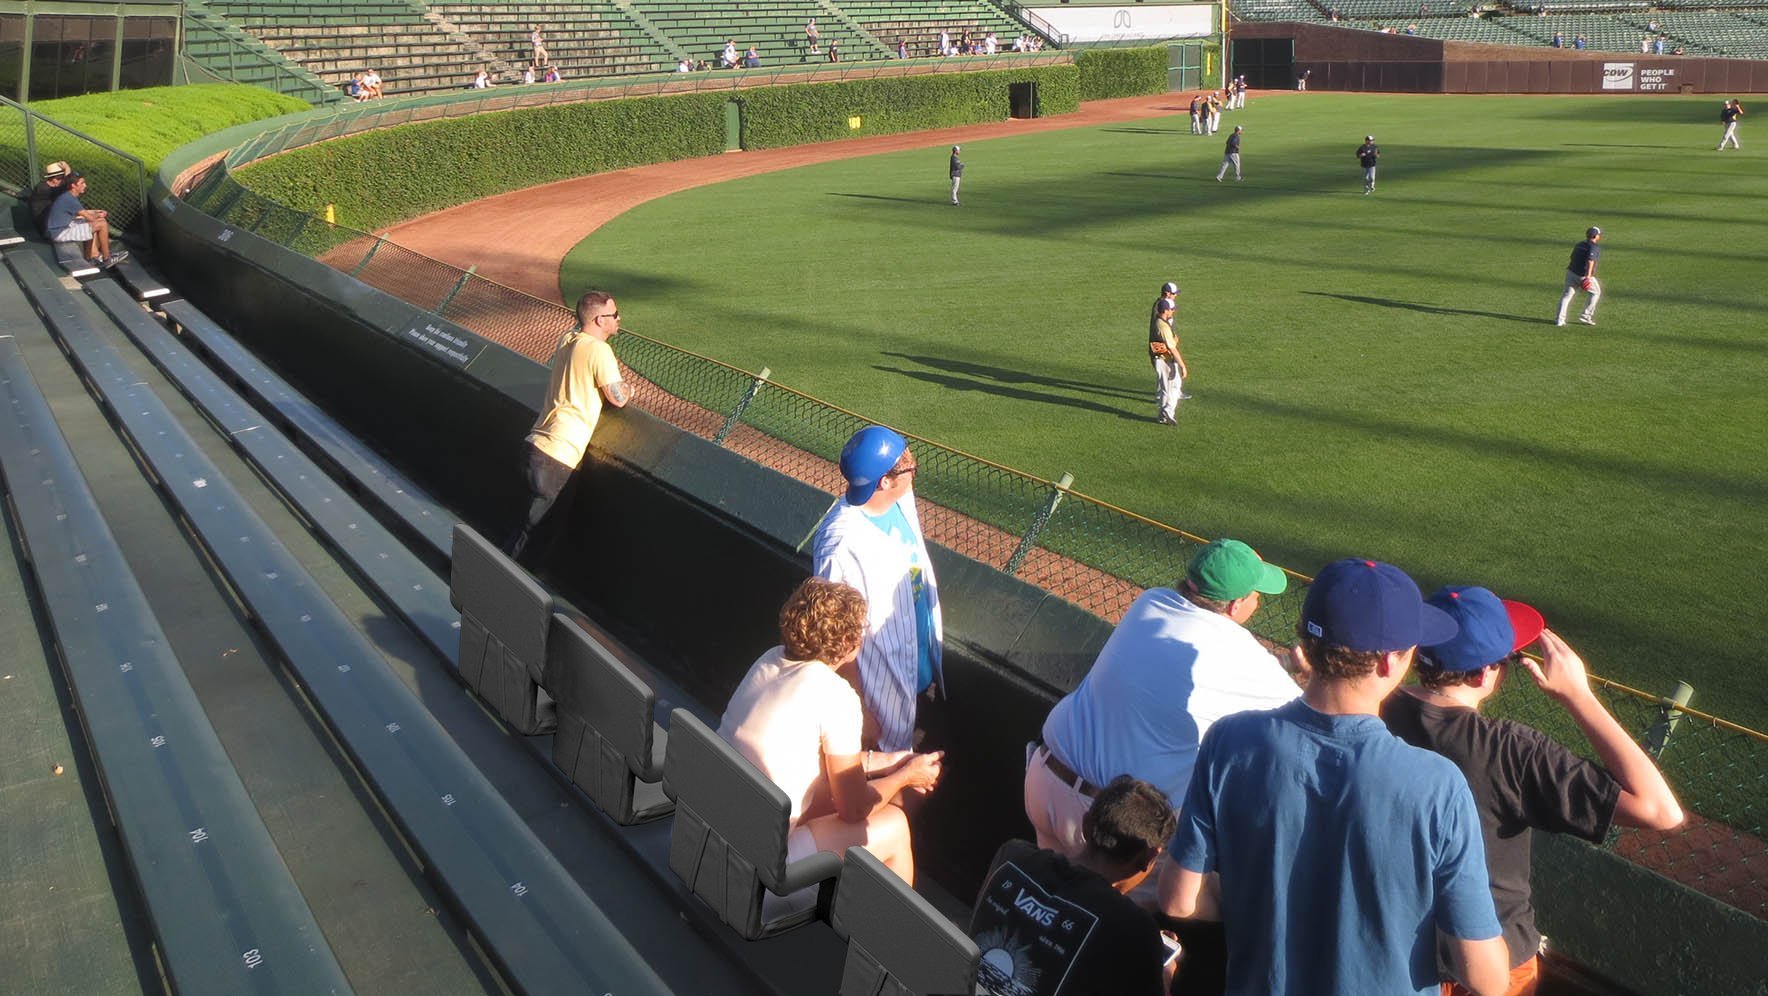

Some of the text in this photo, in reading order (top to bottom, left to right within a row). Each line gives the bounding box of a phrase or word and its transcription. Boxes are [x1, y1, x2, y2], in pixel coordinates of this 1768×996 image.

[190, 827, 208, 843] 104
[511, 882, 528, 896] 104
[1014, 888, 1059, 926] VANS
[1062, 920, 1075, 929] 66
[243, 948, 263, 969] 103
